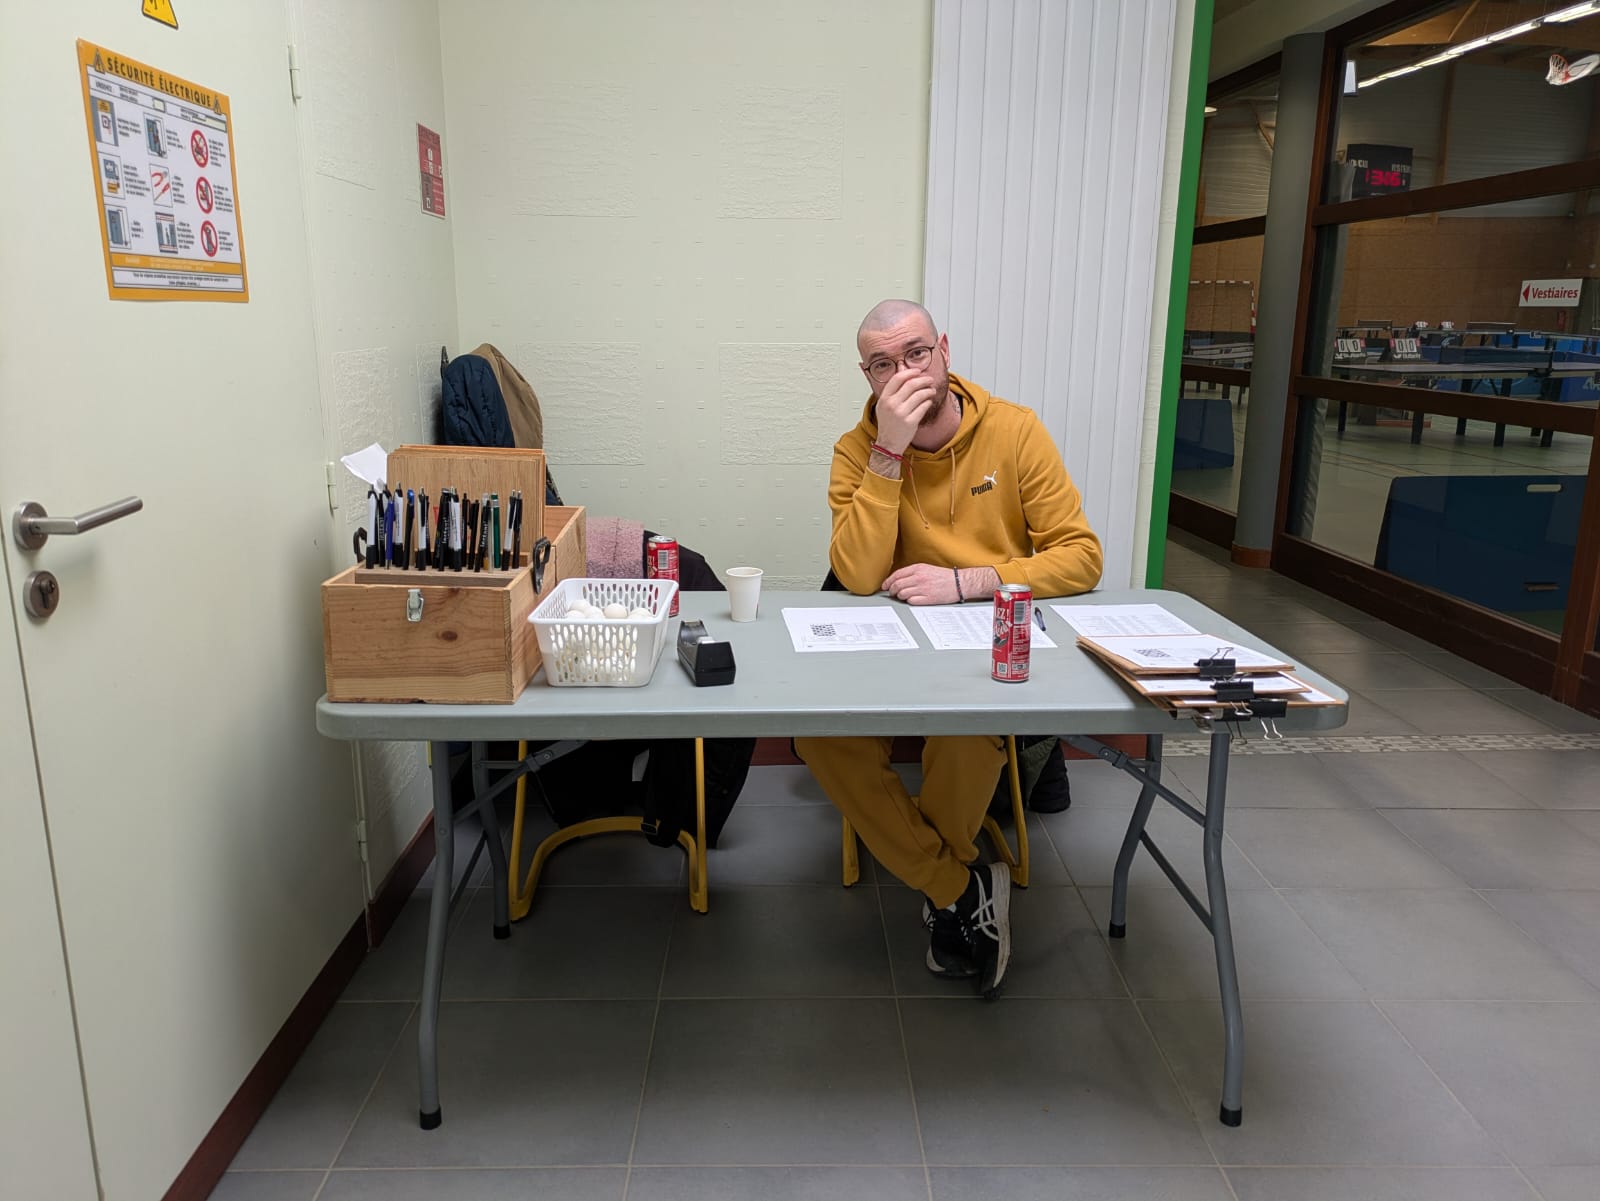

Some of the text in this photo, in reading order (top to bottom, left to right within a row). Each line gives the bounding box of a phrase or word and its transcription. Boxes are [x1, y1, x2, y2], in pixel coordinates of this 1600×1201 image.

[107, 56, 155, 87] SÉCURITÉ
[159, 74, 211, 107] ÉLECTRIQUE
[1532, 286, 1579, 299] Vestiaires
[970, 481, 993, 497] PUMA
